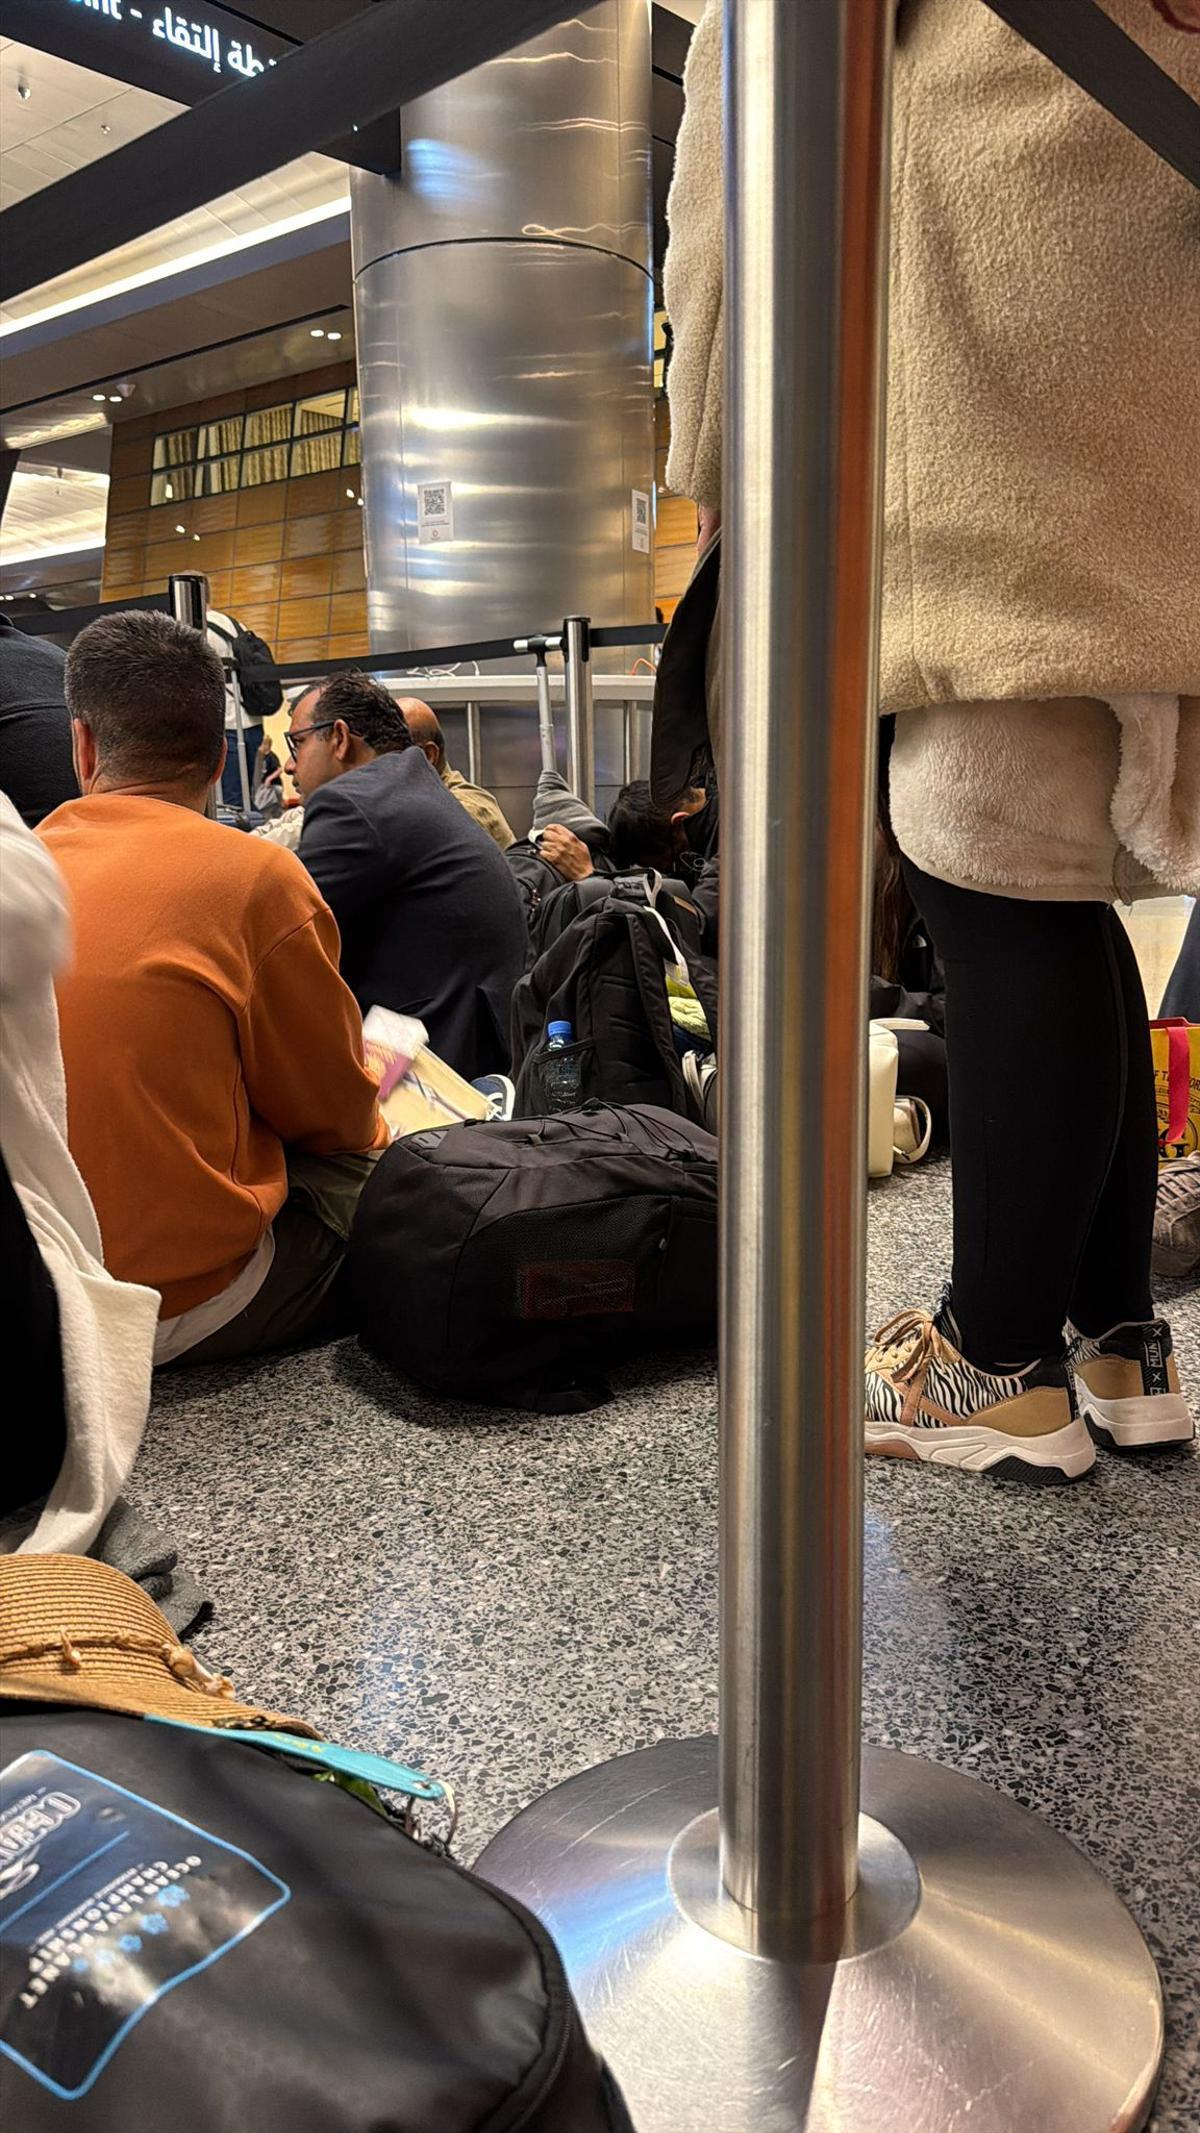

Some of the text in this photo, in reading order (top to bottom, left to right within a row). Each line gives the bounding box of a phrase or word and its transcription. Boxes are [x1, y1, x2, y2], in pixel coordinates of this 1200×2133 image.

[142, 1855, 202, 1895] OCEAN
[28, 1861, 169, 1974] CHAMPIONSHIP
[93, 1893, 145, 1932] LAVA
[19, 1932, 95, 2009] PLANET
